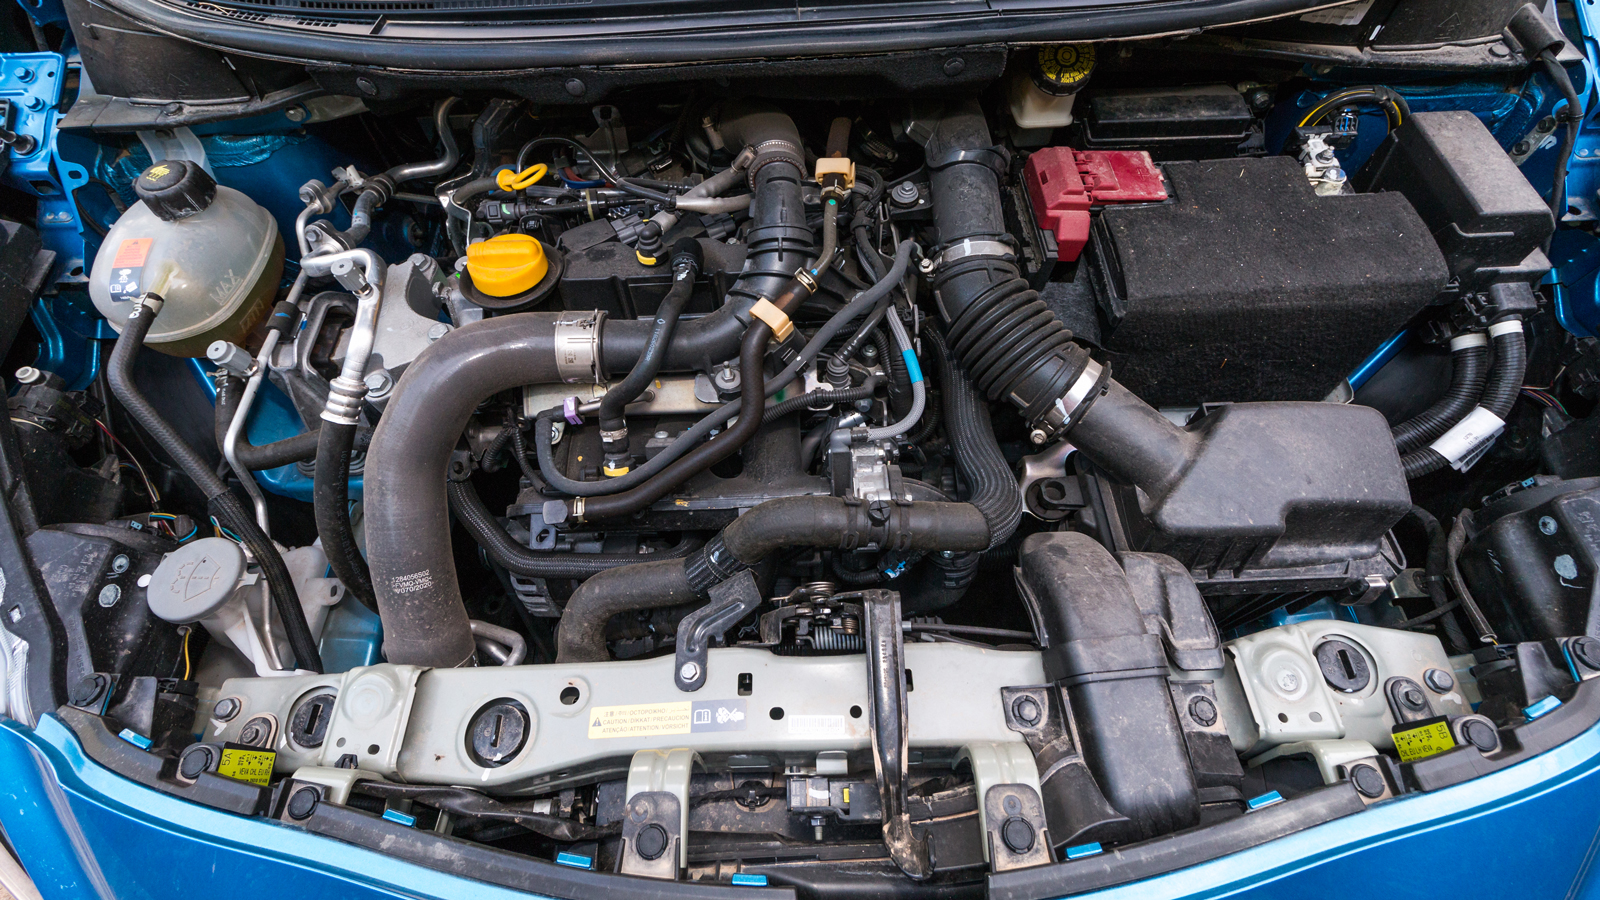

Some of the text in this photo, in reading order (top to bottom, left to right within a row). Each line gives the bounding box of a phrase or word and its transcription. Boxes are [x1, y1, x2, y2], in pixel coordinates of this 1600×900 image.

[209, 269, 243, 306] MAX
[603, 718, 628, 726] CAUTION
[602, 726, 628, 734] ATENÇÃO
[1436, 724, 1448, 740] 5B
[221, 752, 233, 766] 5A
